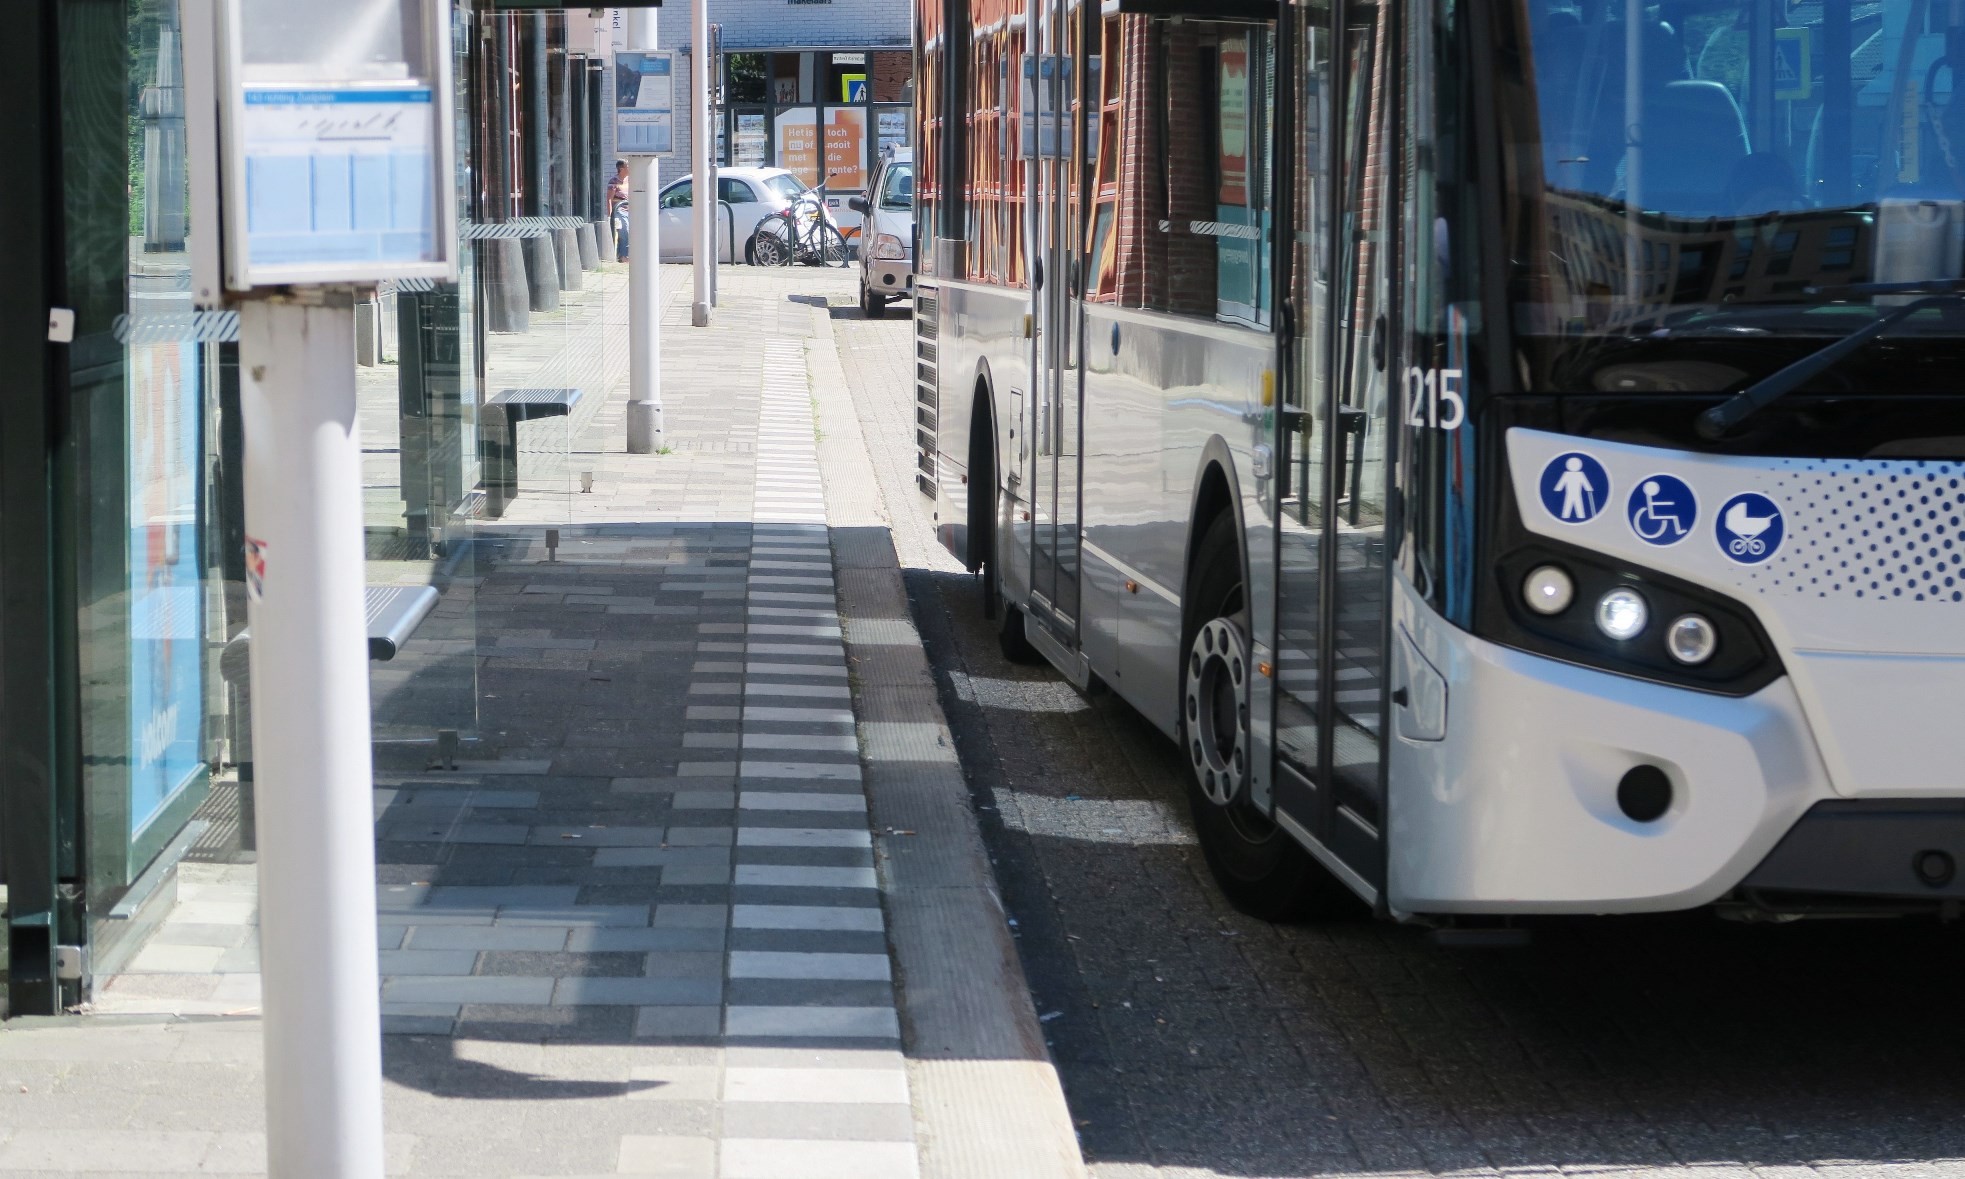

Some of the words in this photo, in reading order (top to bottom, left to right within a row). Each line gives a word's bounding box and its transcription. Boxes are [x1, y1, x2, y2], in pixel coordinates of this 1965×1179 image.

[788, 128, 804, 137] Het
[805, 128, 814, 137] is
[827, 128, 847, 137] toch
[804, 140, 814, 149] of
[827, 140, 851, 149] nooit
[827, 153, 842, 161] die
[827, 165, 858, 174] rente?
[1402, 366, 1465, 430] 1215
